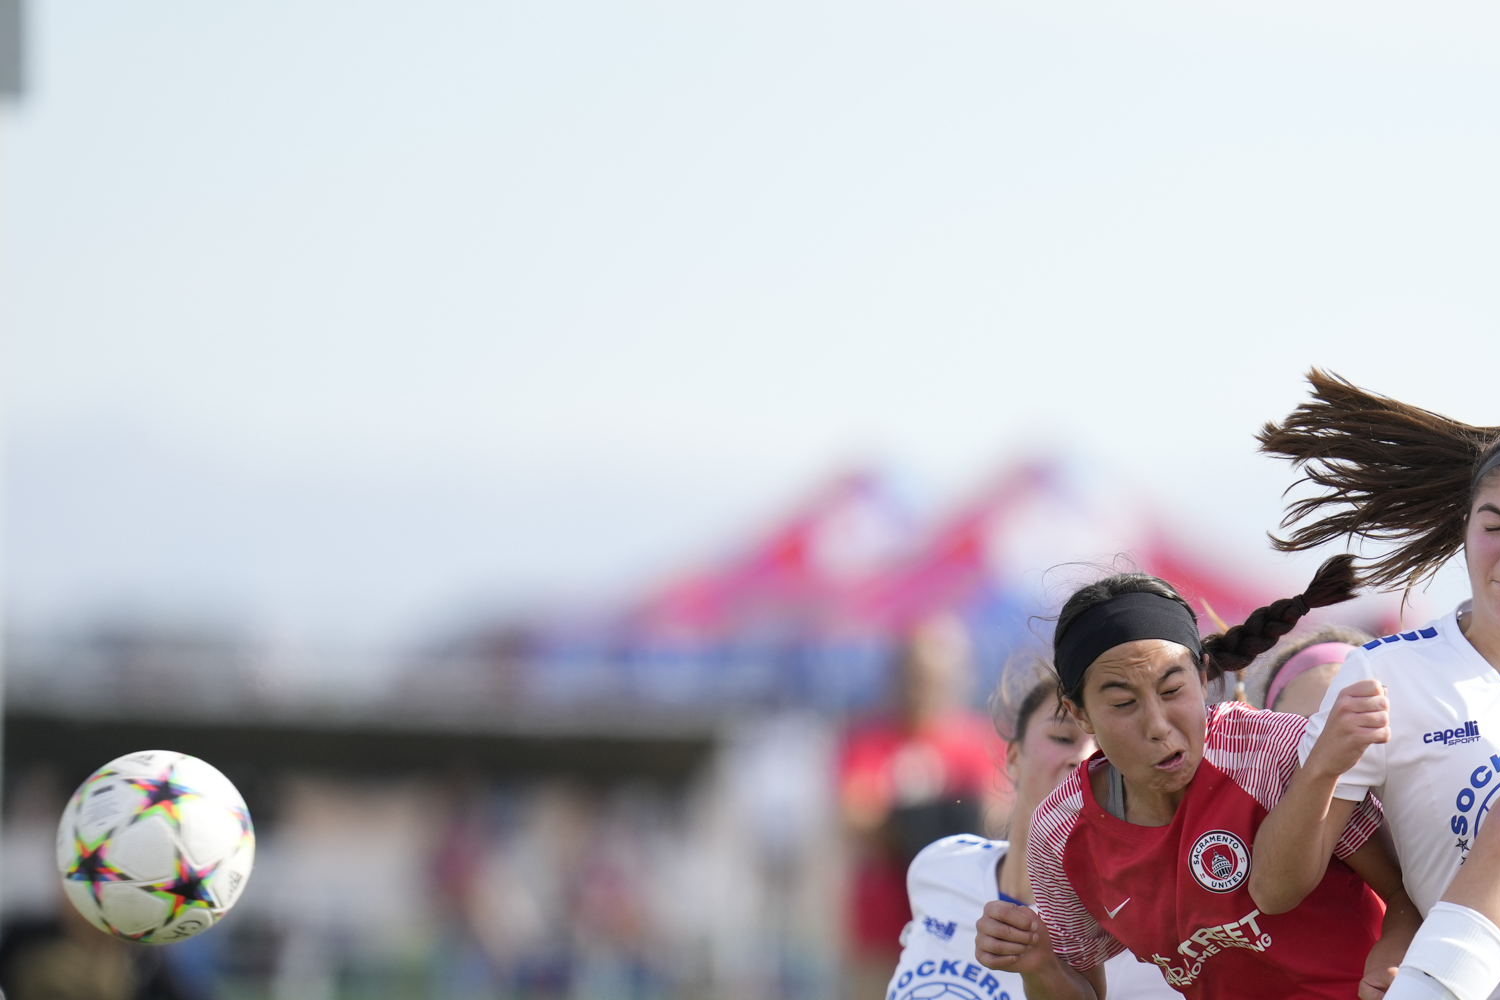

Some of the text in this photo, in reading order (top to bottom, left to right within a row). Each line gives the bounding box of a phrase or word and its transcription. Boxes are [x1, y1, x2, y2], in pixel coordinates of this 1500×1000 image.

[1423, 720, 1479, 745] capelli
[1448, 735, 1481, 746] SPORT
[1193, 834, 1240, 865] SACRAMENTO
[1211, 870, 1243, 889] UNITED
